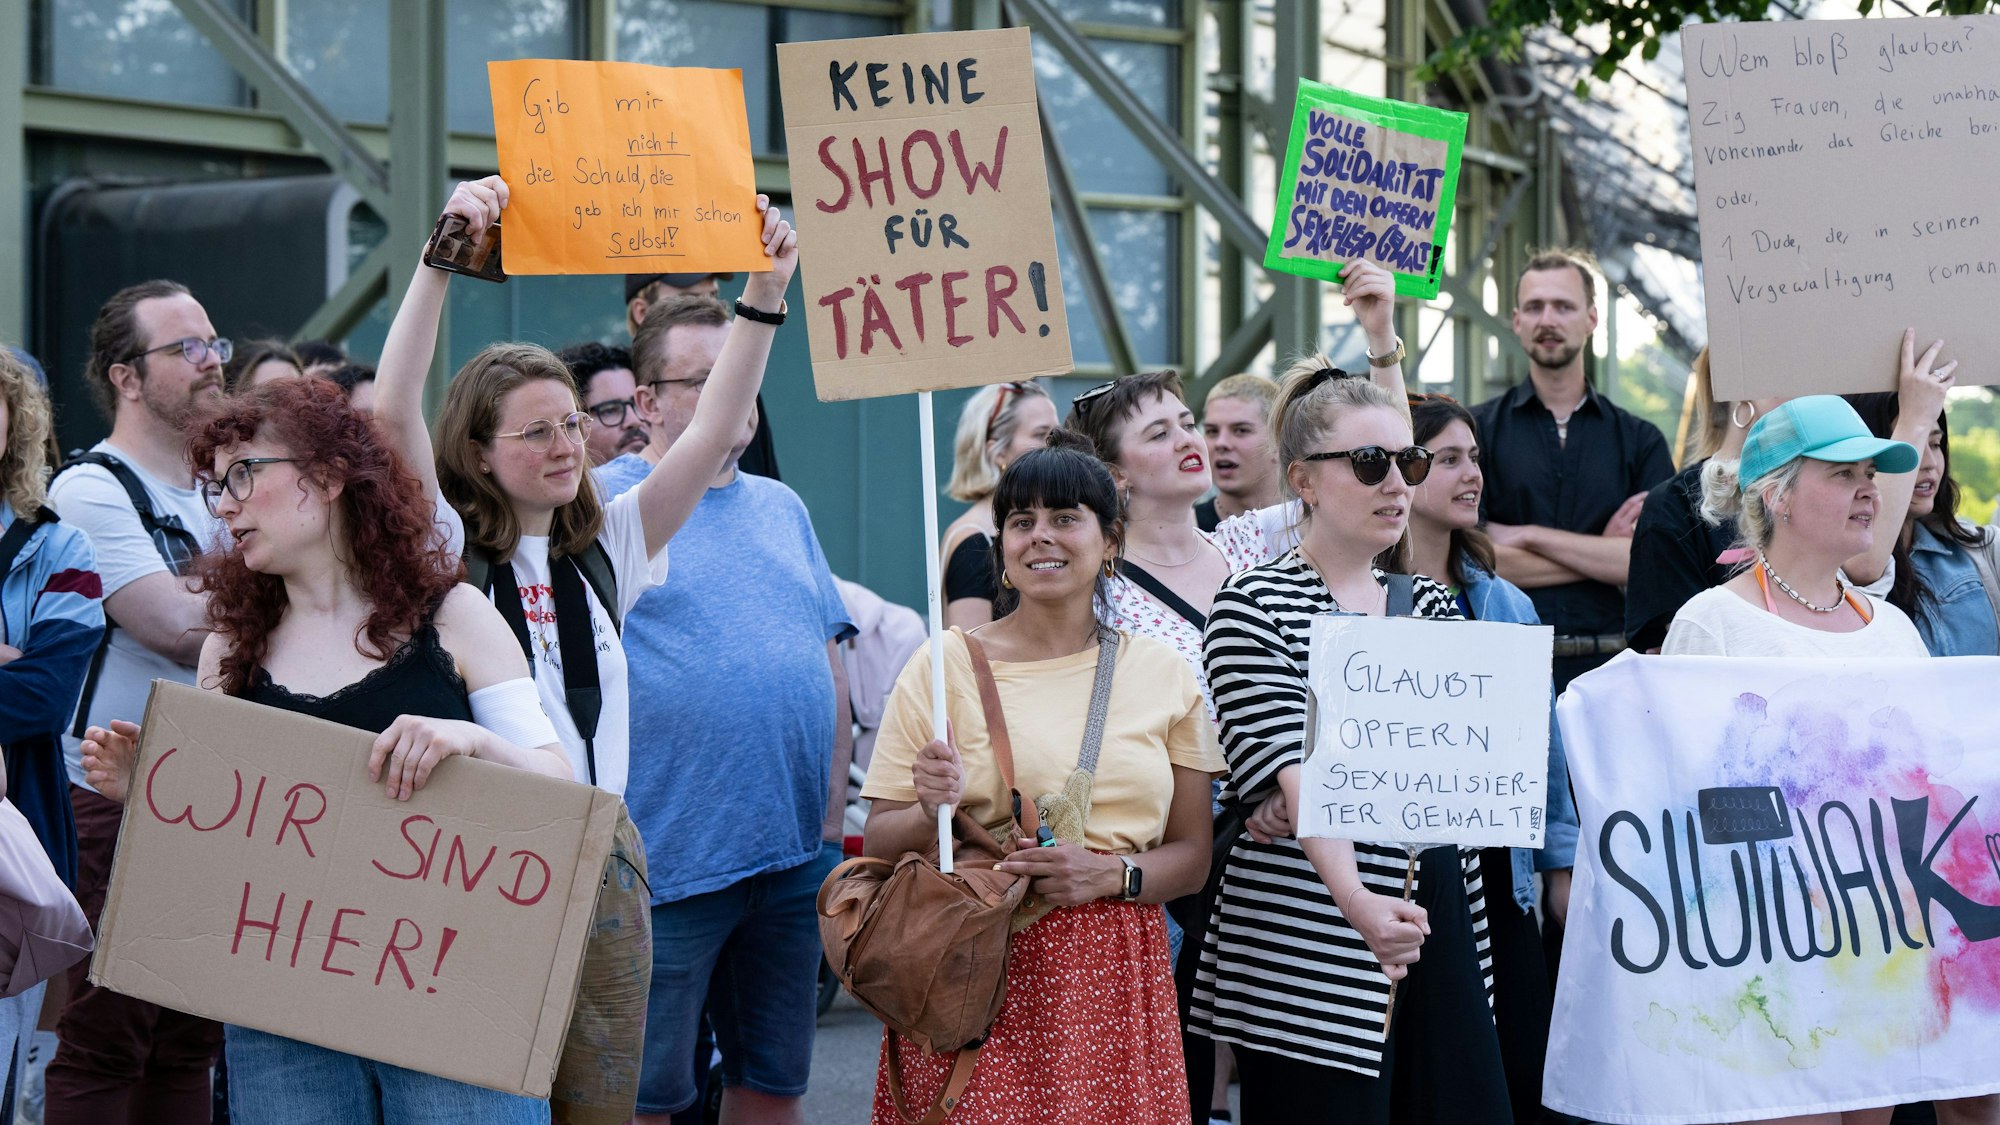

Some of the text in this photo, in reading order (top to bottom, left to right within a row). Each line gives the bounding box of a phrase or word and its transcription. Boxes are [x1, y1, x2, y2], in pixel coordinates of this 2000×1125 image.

[1700, 26, 1974, 77] Wem bloß glauben?
[524, 78, 663, 134] Gib mir
[829, 58, 985, 111] KEINE
[1309, 111, 1366, 148] VOLLE
[1702, 101, 1746, 134] Zig
[1771, 97, 1848, 120] Frauen,
[1874, 91, 1904, 115] die
[627, 132, 678, 153] nicht
[1828, 133, 1854, 149] das
[1880, 120, 1943, 142] Gleiche
[526, 157, 675, 193] die Schuld, die
[815, 125, 1008, 214] SHOW
[573, 198, 741, 229] geb ich mir schon
[1330, 187, 1369, 219] DEN
[1369, 196, 1436, 231] OPFERN
[1716, 190, 1758, 209] oder,
[608, 227, 679, 254] Selbst!
[885, 209, 969, 255] FÜR
[1375, 223, 1443, 284] GEWALT!
[1722, 235, 1733, 261] 1
[1752, 230, 1801, 254] Dude,
[1825, 227, 1849, 244] der
[1875, 224, 1888, 238] in
[1727, 267, 1894, 304] Vergewaltigung
[818, 261, 1050, 360] TÄTER!
[1344, 650, 1493, 699] GLAUBT
[1339, 718, 1489, 752] OPFERN
[146, 748, 551, 906] WIR SIND
[1322, 802, 1542, 841] TER GEWALT!
[231, 882, 458, 994] HIER!
